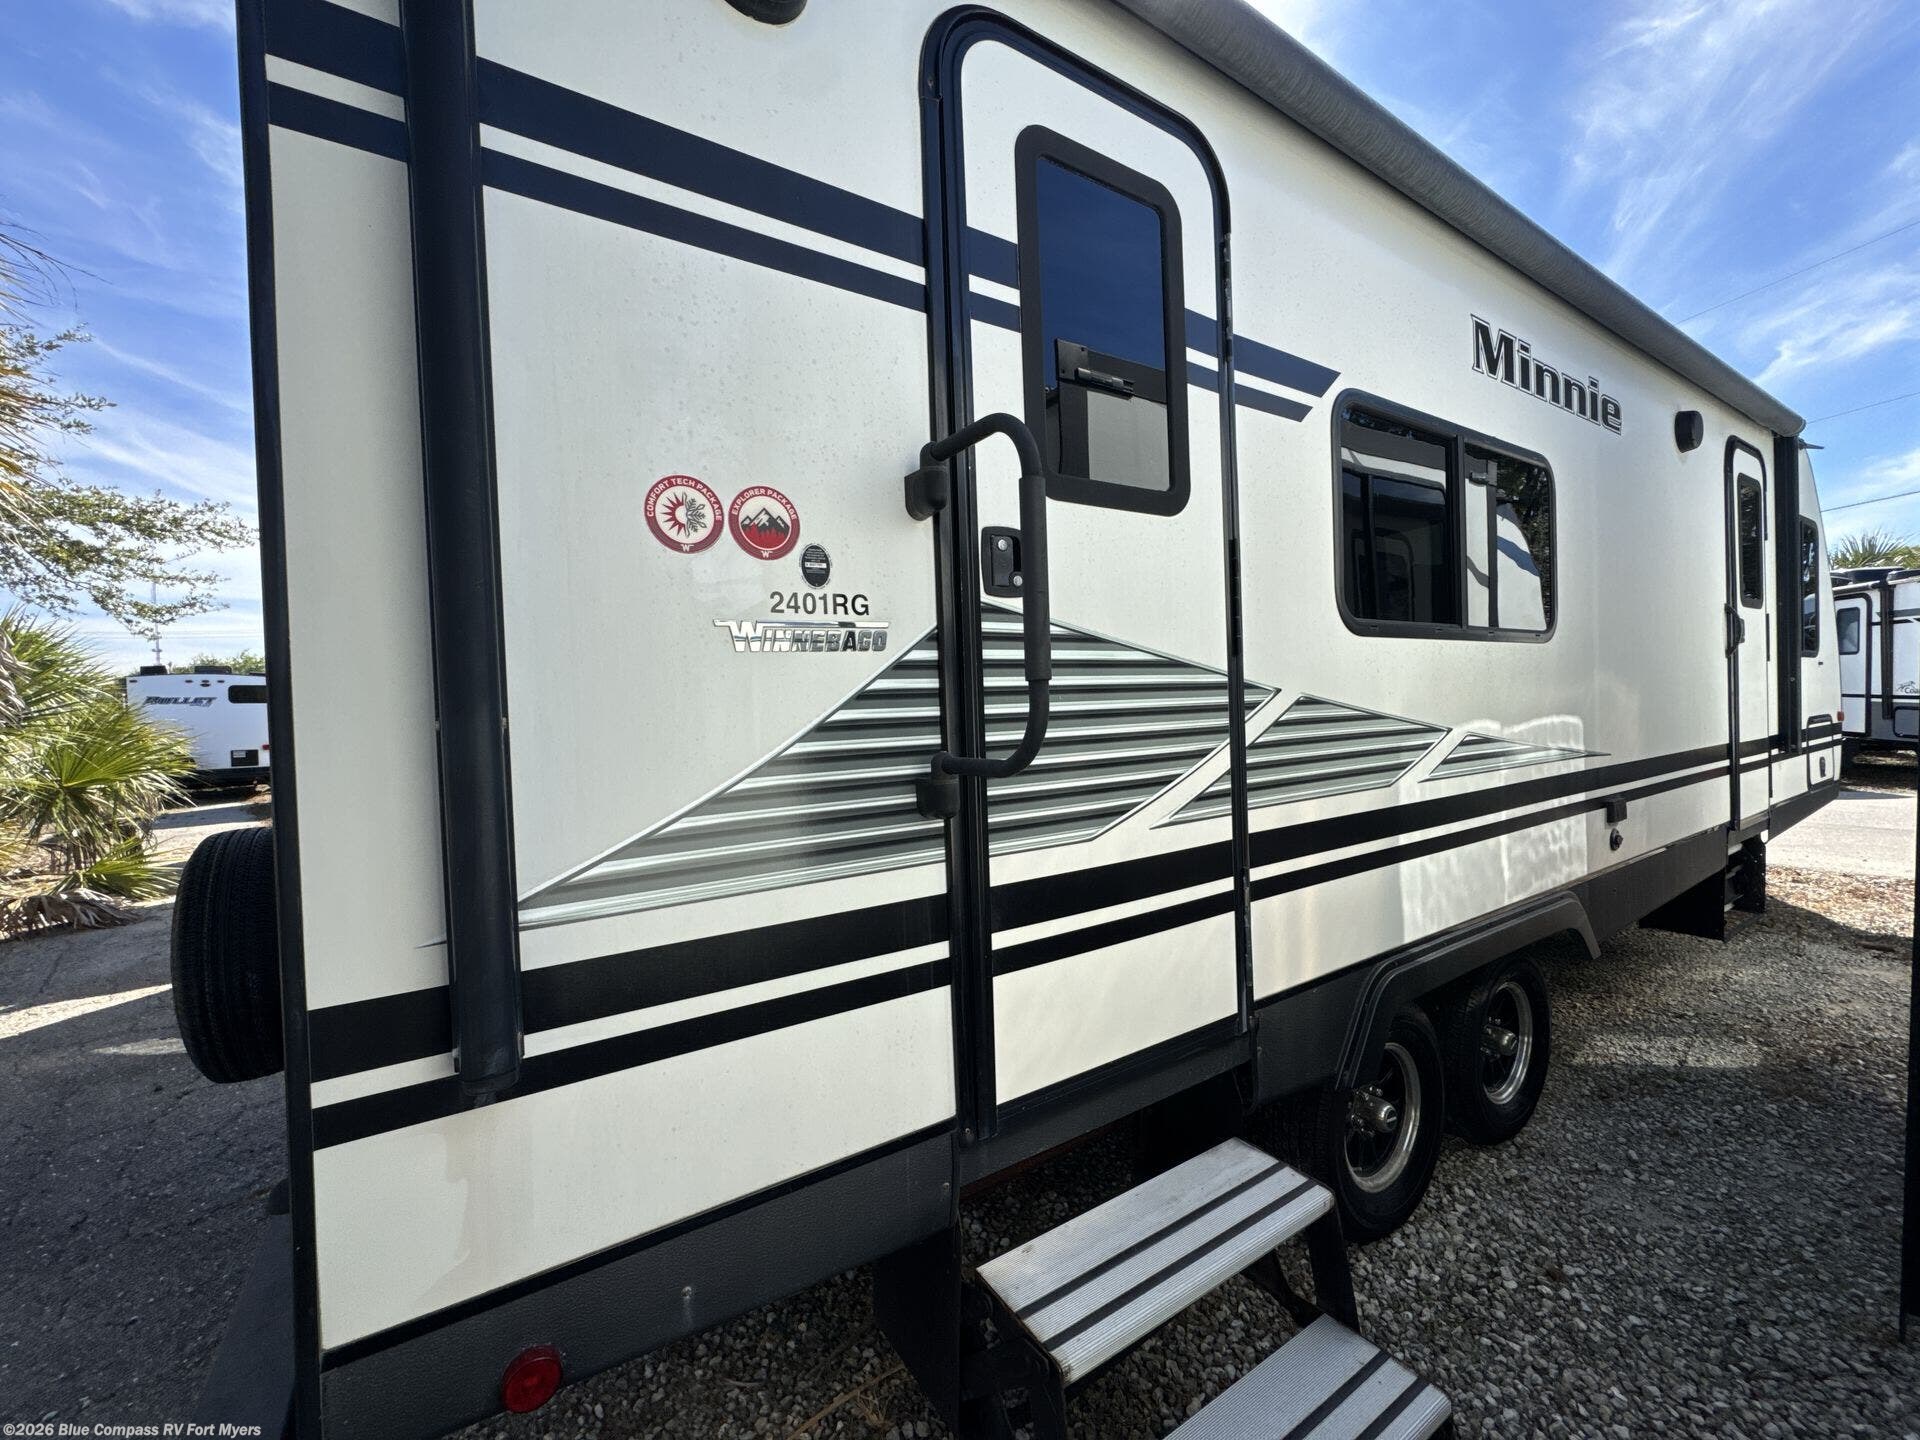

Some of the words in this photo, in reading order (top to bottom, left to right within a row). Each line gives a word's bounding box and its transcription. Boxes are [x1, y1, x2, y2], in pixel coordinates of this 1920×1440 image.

[1471, 313, 1622, 436] Minnie
[646, 480, 669, 517] COMFORT
[670, 478, 696, 487] TECH
[696, 483, 723, 521] PACKAGE
[731, 488, 766, 516] EXPLORER
[767, 489, 798, 520] PACKAGE
[769, 591, 870, 616] 2401RG
[713, 619, 891, 652] WINNEBAGO
